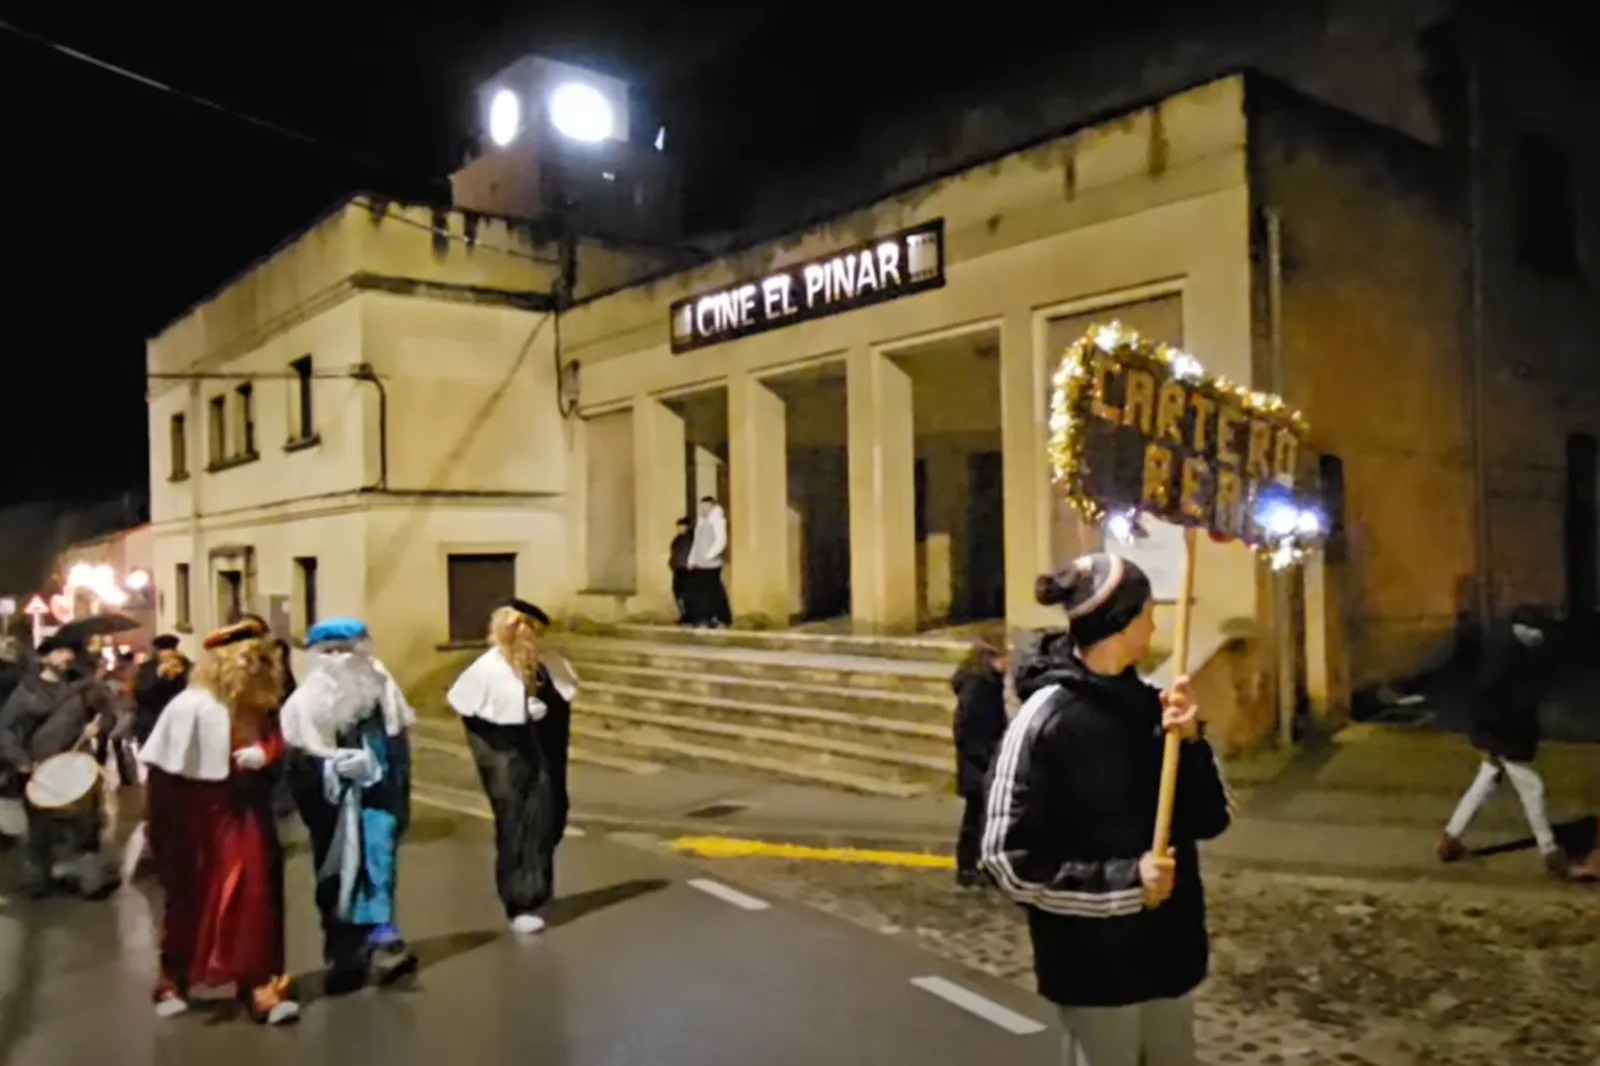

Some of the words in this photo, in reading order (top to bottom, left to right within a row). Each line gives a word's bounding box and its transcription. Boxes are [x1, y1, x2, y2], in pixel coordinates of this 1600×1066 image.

[697, 285, 755, 337] CINE
[762, 273, 797, 319] EL
[804, 242, 900, 308] PINAR
[1090, 358, 1298, 487] CARTERO
